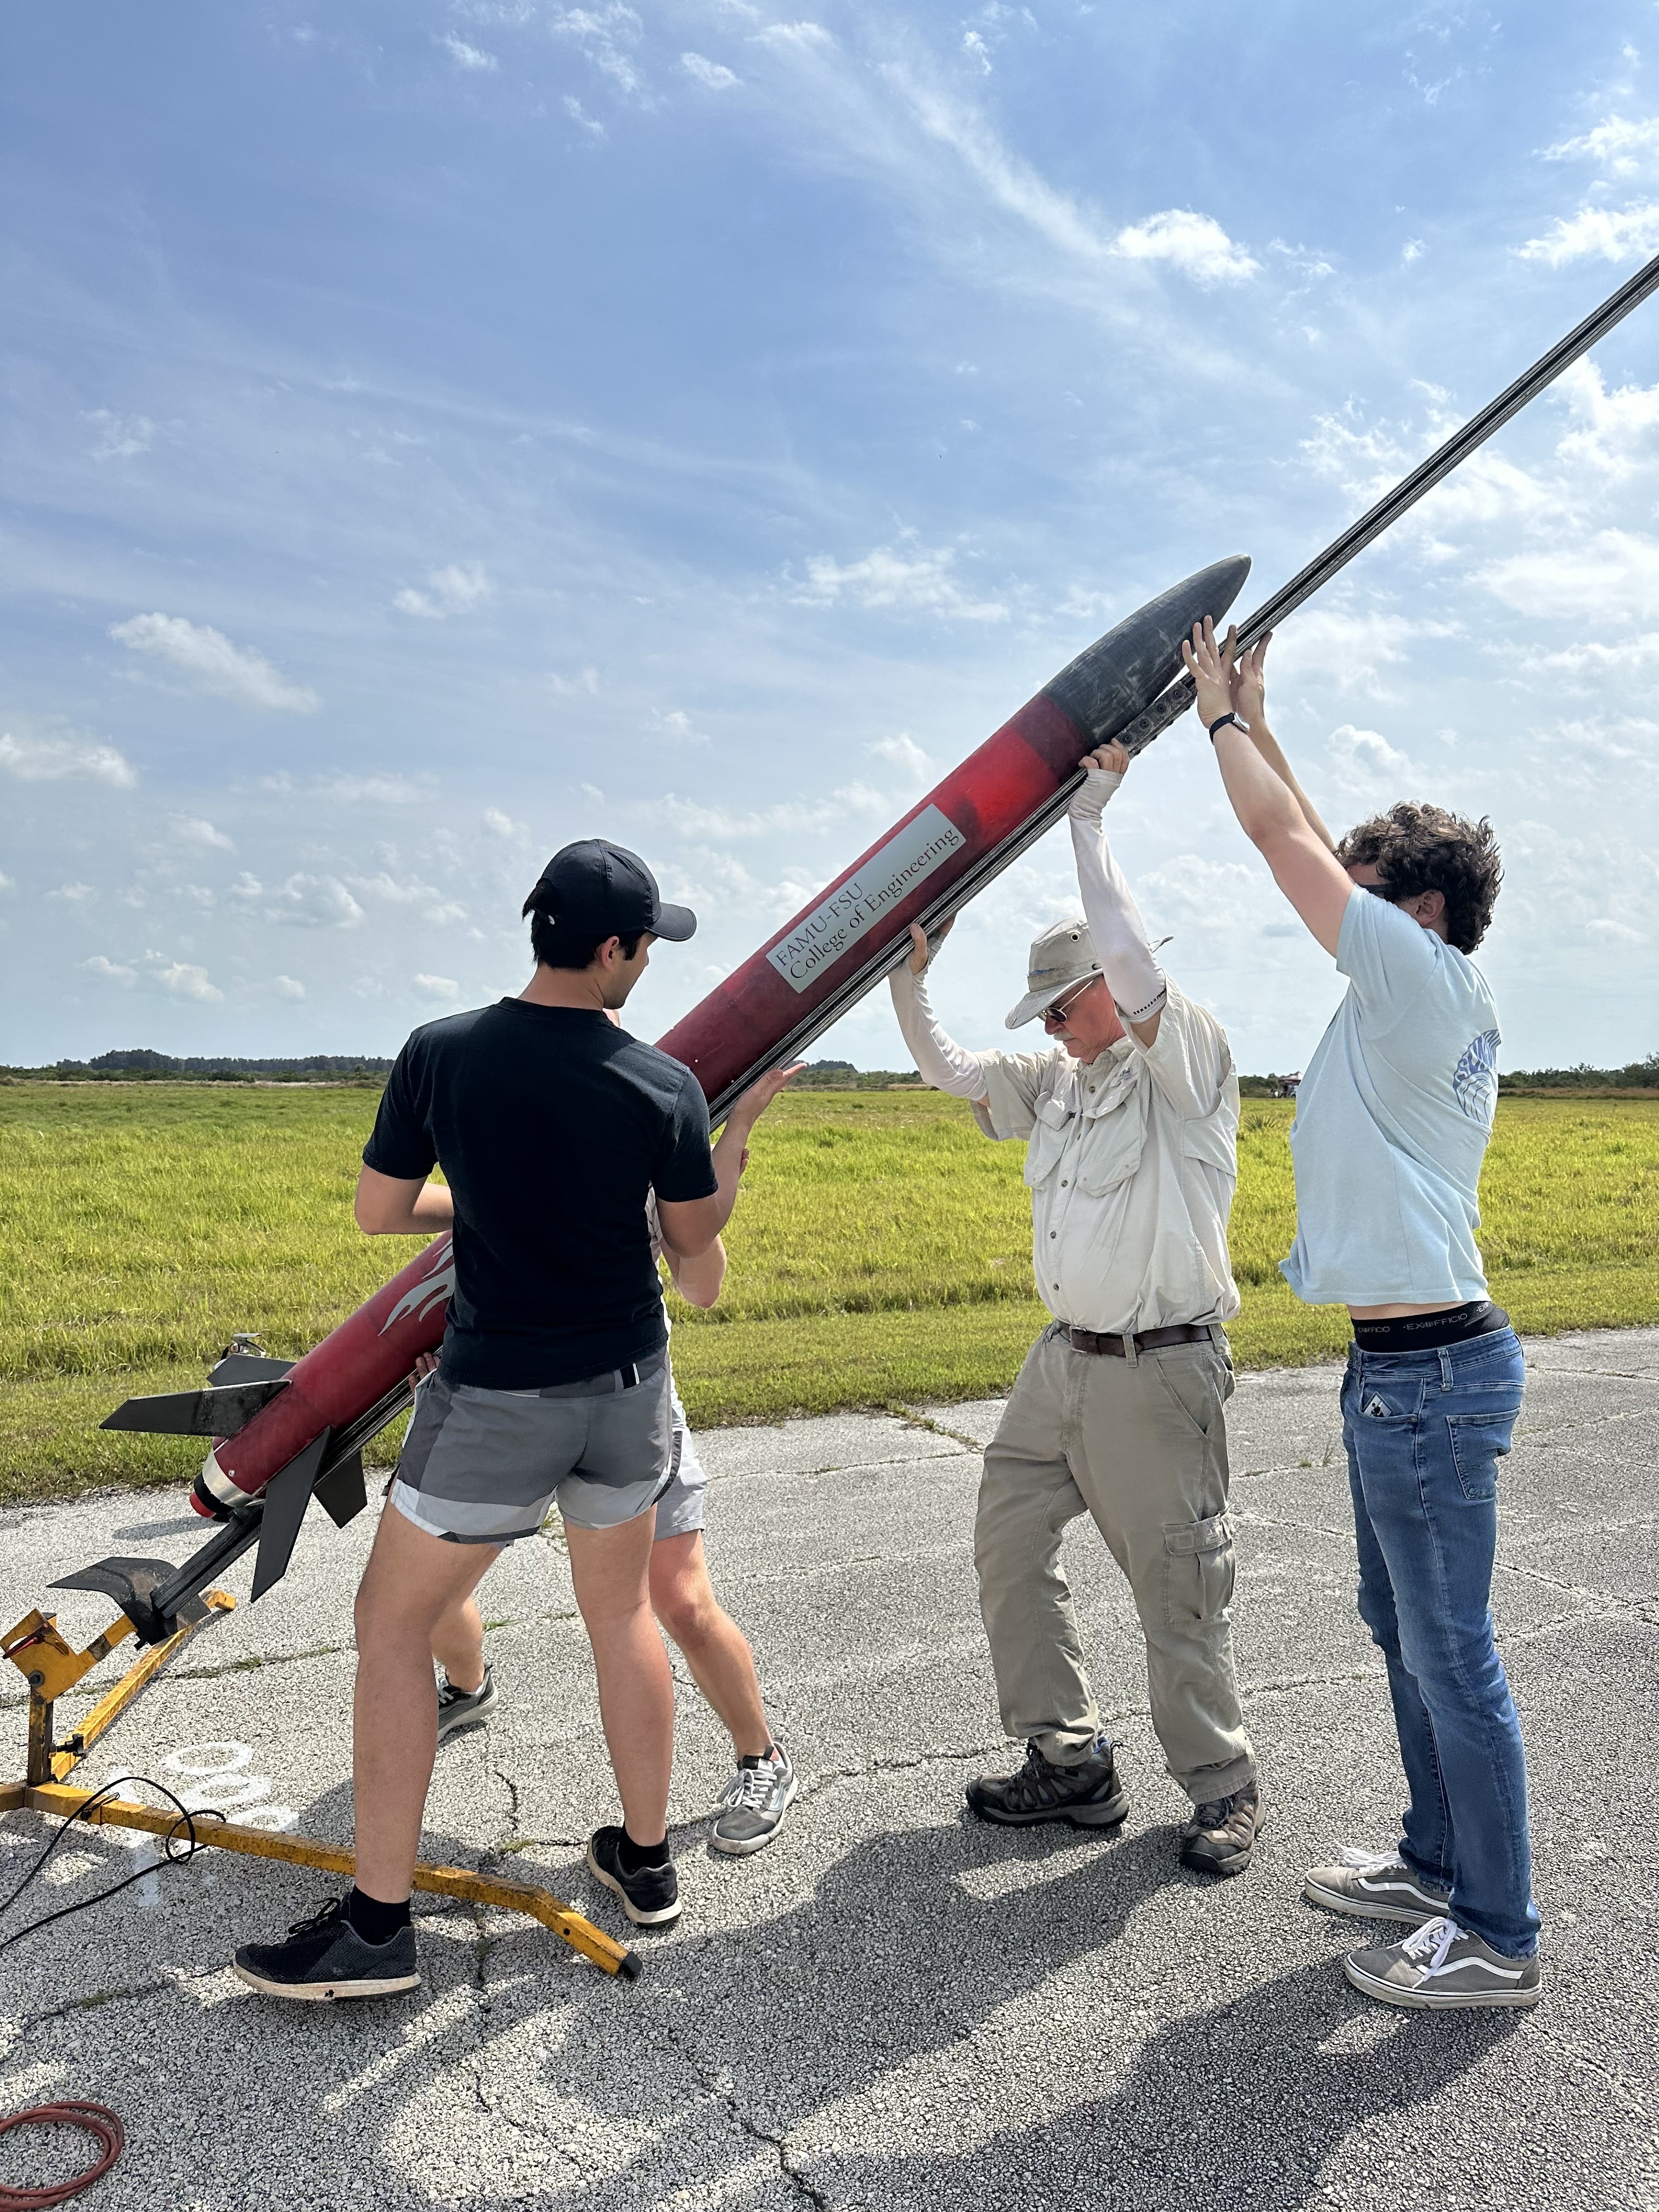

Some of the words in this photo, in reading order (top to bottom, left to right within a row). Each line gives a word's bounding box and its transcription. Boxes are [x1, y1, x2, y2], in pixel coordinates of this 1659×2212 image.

[775, 882, 863, 967] FAMU-FSU
[790, 928, 848, 979] College
[849, 904, 866, 928] of
[863, 828, 960, 913] Engineering
